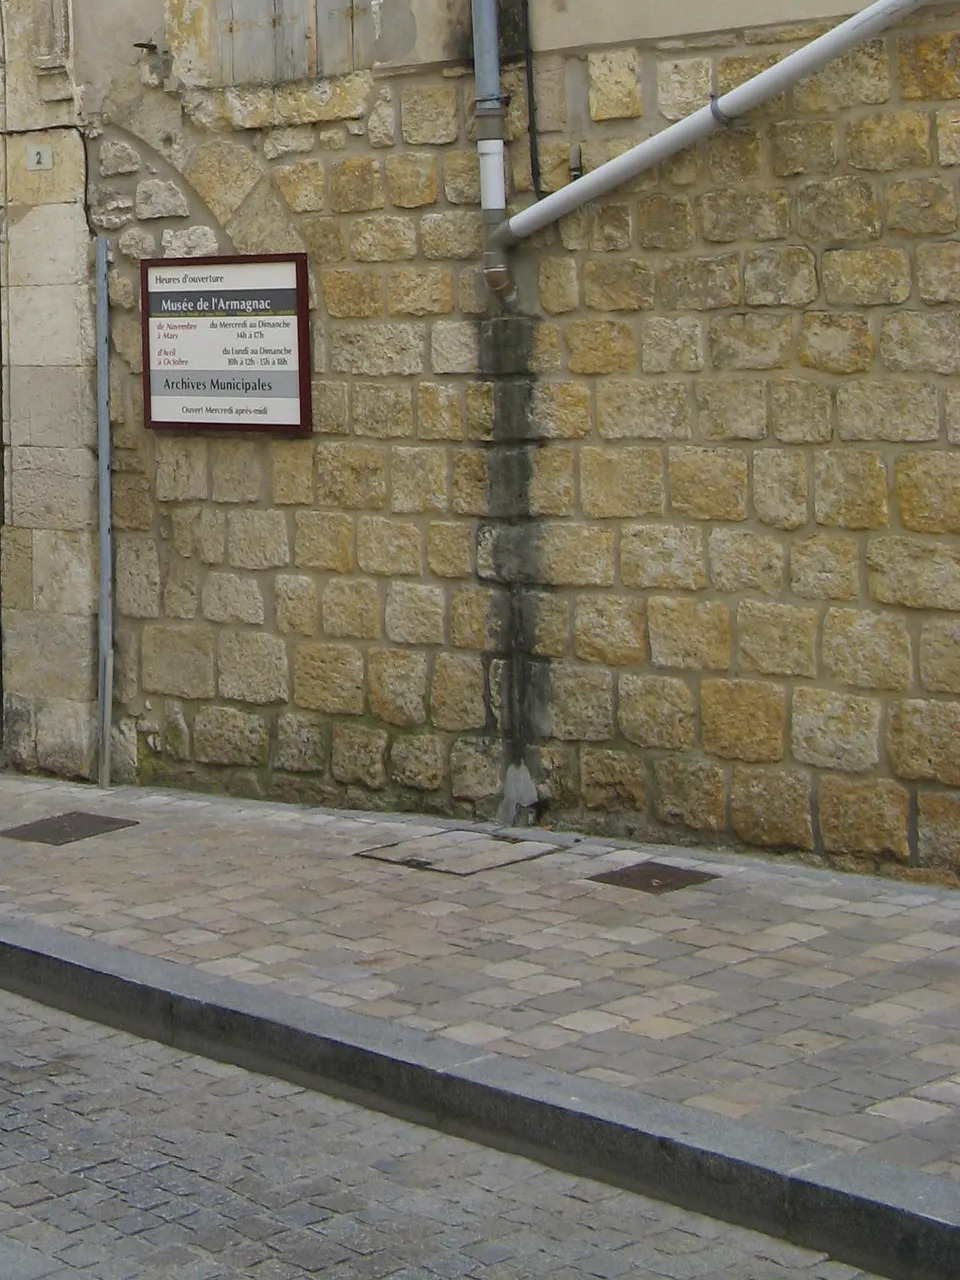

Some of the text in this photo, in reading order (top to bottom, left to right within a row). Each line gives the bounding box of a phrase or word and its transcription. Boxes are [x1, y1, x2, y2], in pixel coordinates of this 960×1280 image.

[35, 151, 43, 165] 2
[155, 274, 225, 285] Heures d'ouverture
[161, 297, 271, 313] Musée de l'Armagnac
[166, 321, 197, 330] Novembre
[209, 321, 218, 329] du
[220, 320, 248, 328] Mercredi
[258, 320, 291, 329] Dimanche
[222, 347, 230, 355] du
[231, 347, 249, 355] Lundi
[259, 347, 292, 355] Dimanche
[163, 378, 272, 394] Archives Municipales
[182, 405, 204, 414] Ouvert
[205, 405, 234, 415] Mercredi
